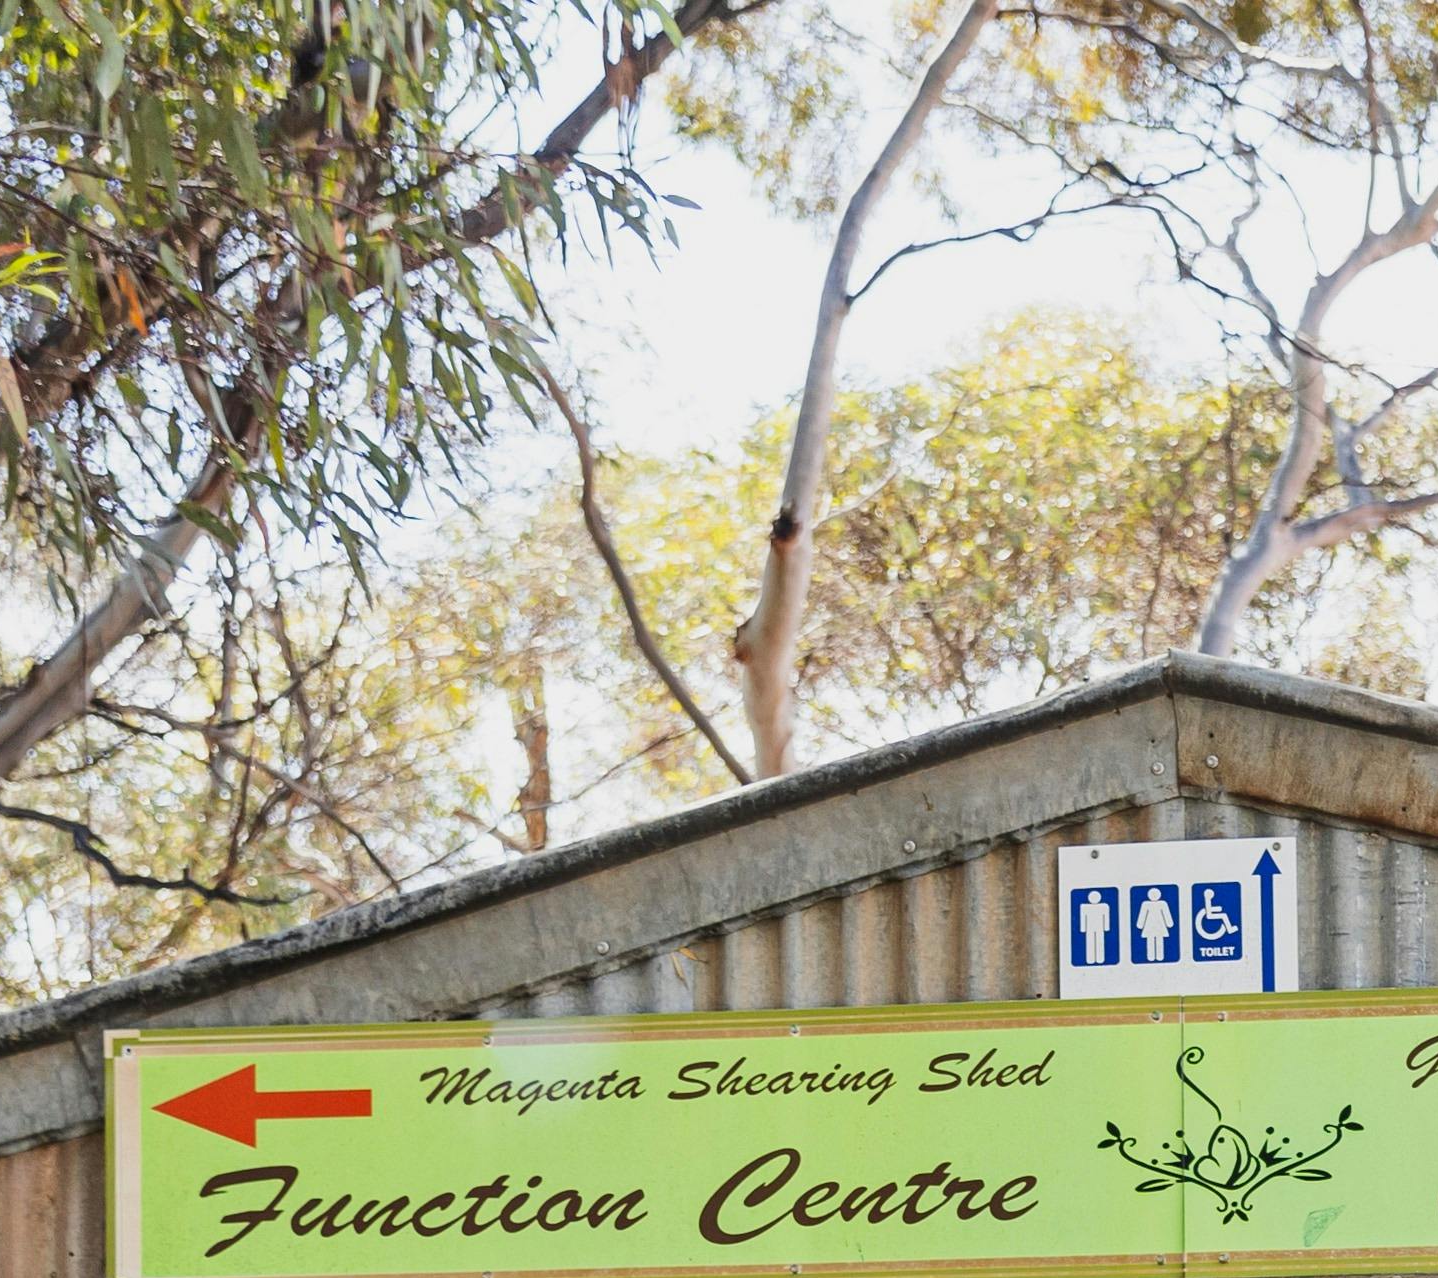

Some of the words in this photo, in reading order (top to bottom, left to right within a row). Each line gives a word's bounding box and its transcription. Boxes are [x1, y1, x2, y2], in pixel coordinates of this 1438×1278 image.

[1200, 946, 1235, 957] TOILET
[419, 1066, 644, 1117] Magenta
[667, 1060, 899, 1115] Shearing
[918, 1047, 1056, 1094] Shed
[199, 1164, 648, 1257] Function
[698, 1148, 1040, 1245] Centre
